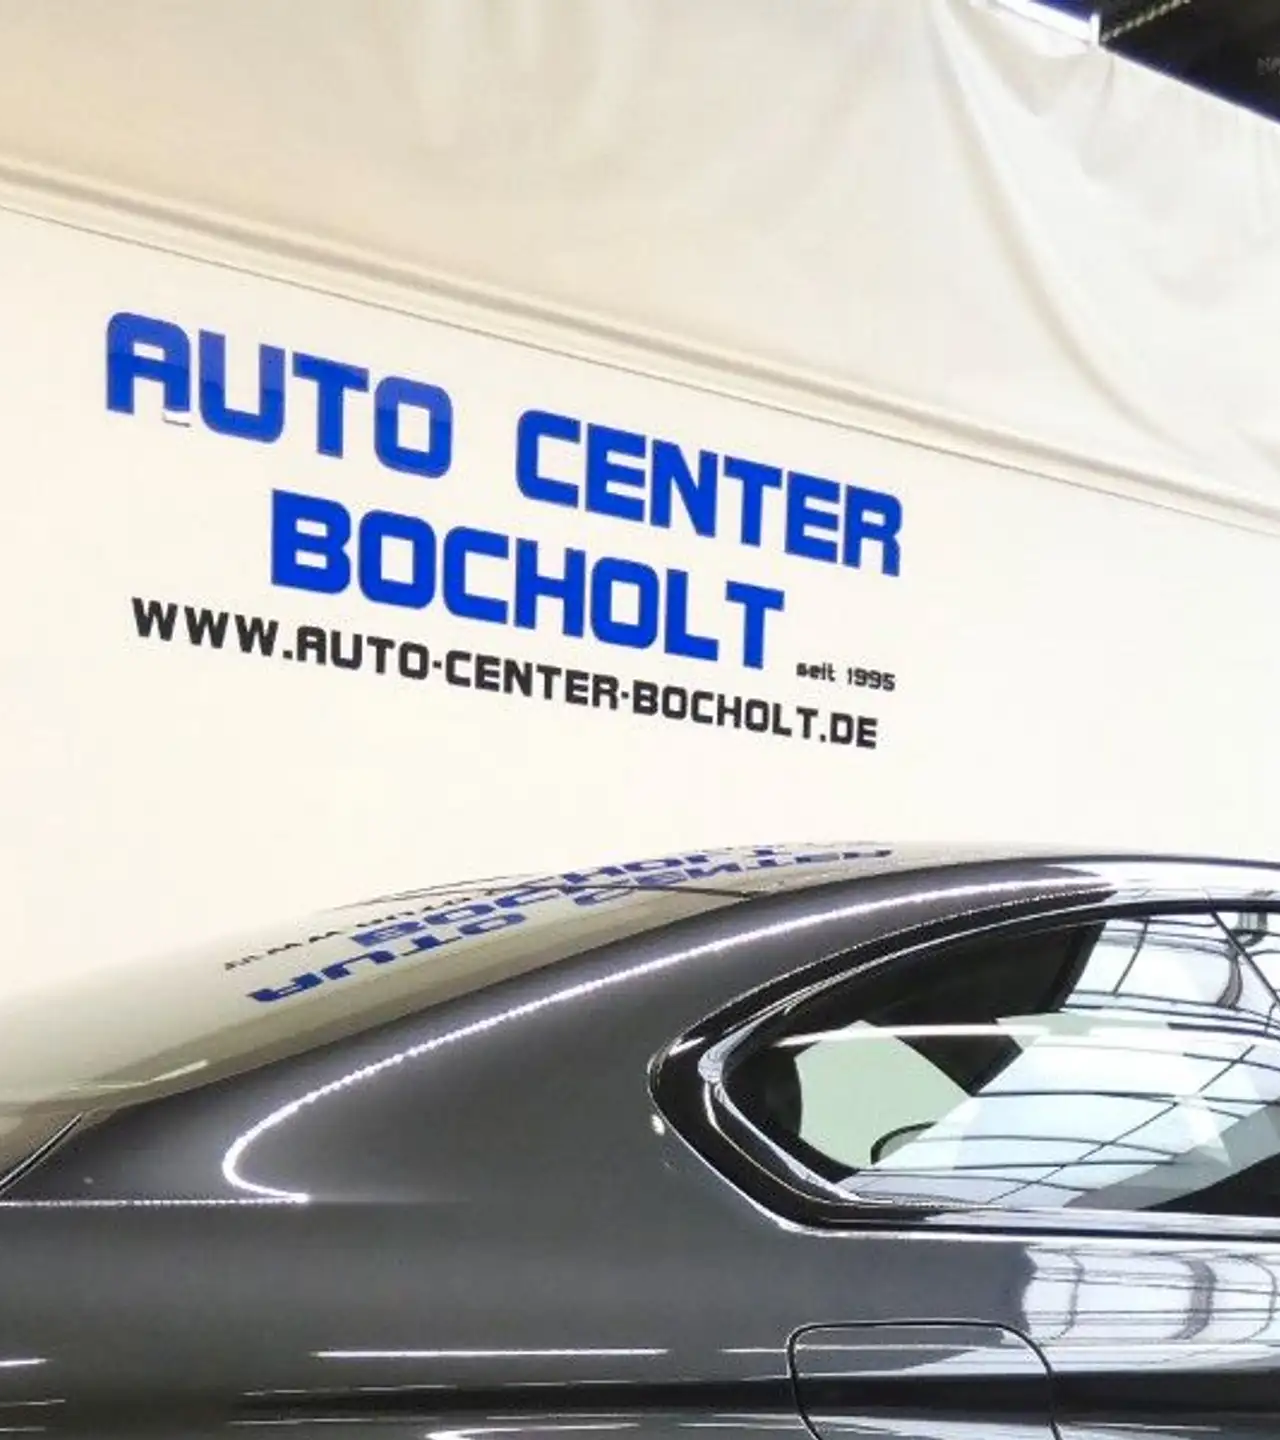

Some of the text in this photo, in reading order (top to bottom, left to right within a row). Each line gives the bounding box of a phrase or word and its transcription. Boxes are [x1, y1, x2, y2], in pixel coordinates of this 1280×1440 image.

[107, 312, 904, 577] AUTO CENTER
[270, 489, 786, 670] BOCHOLT
[131, 597, 878, 750] WWW.AUTO-CENTER-BOCHOLT.DE
[847, 667, 896, 692] 1995
